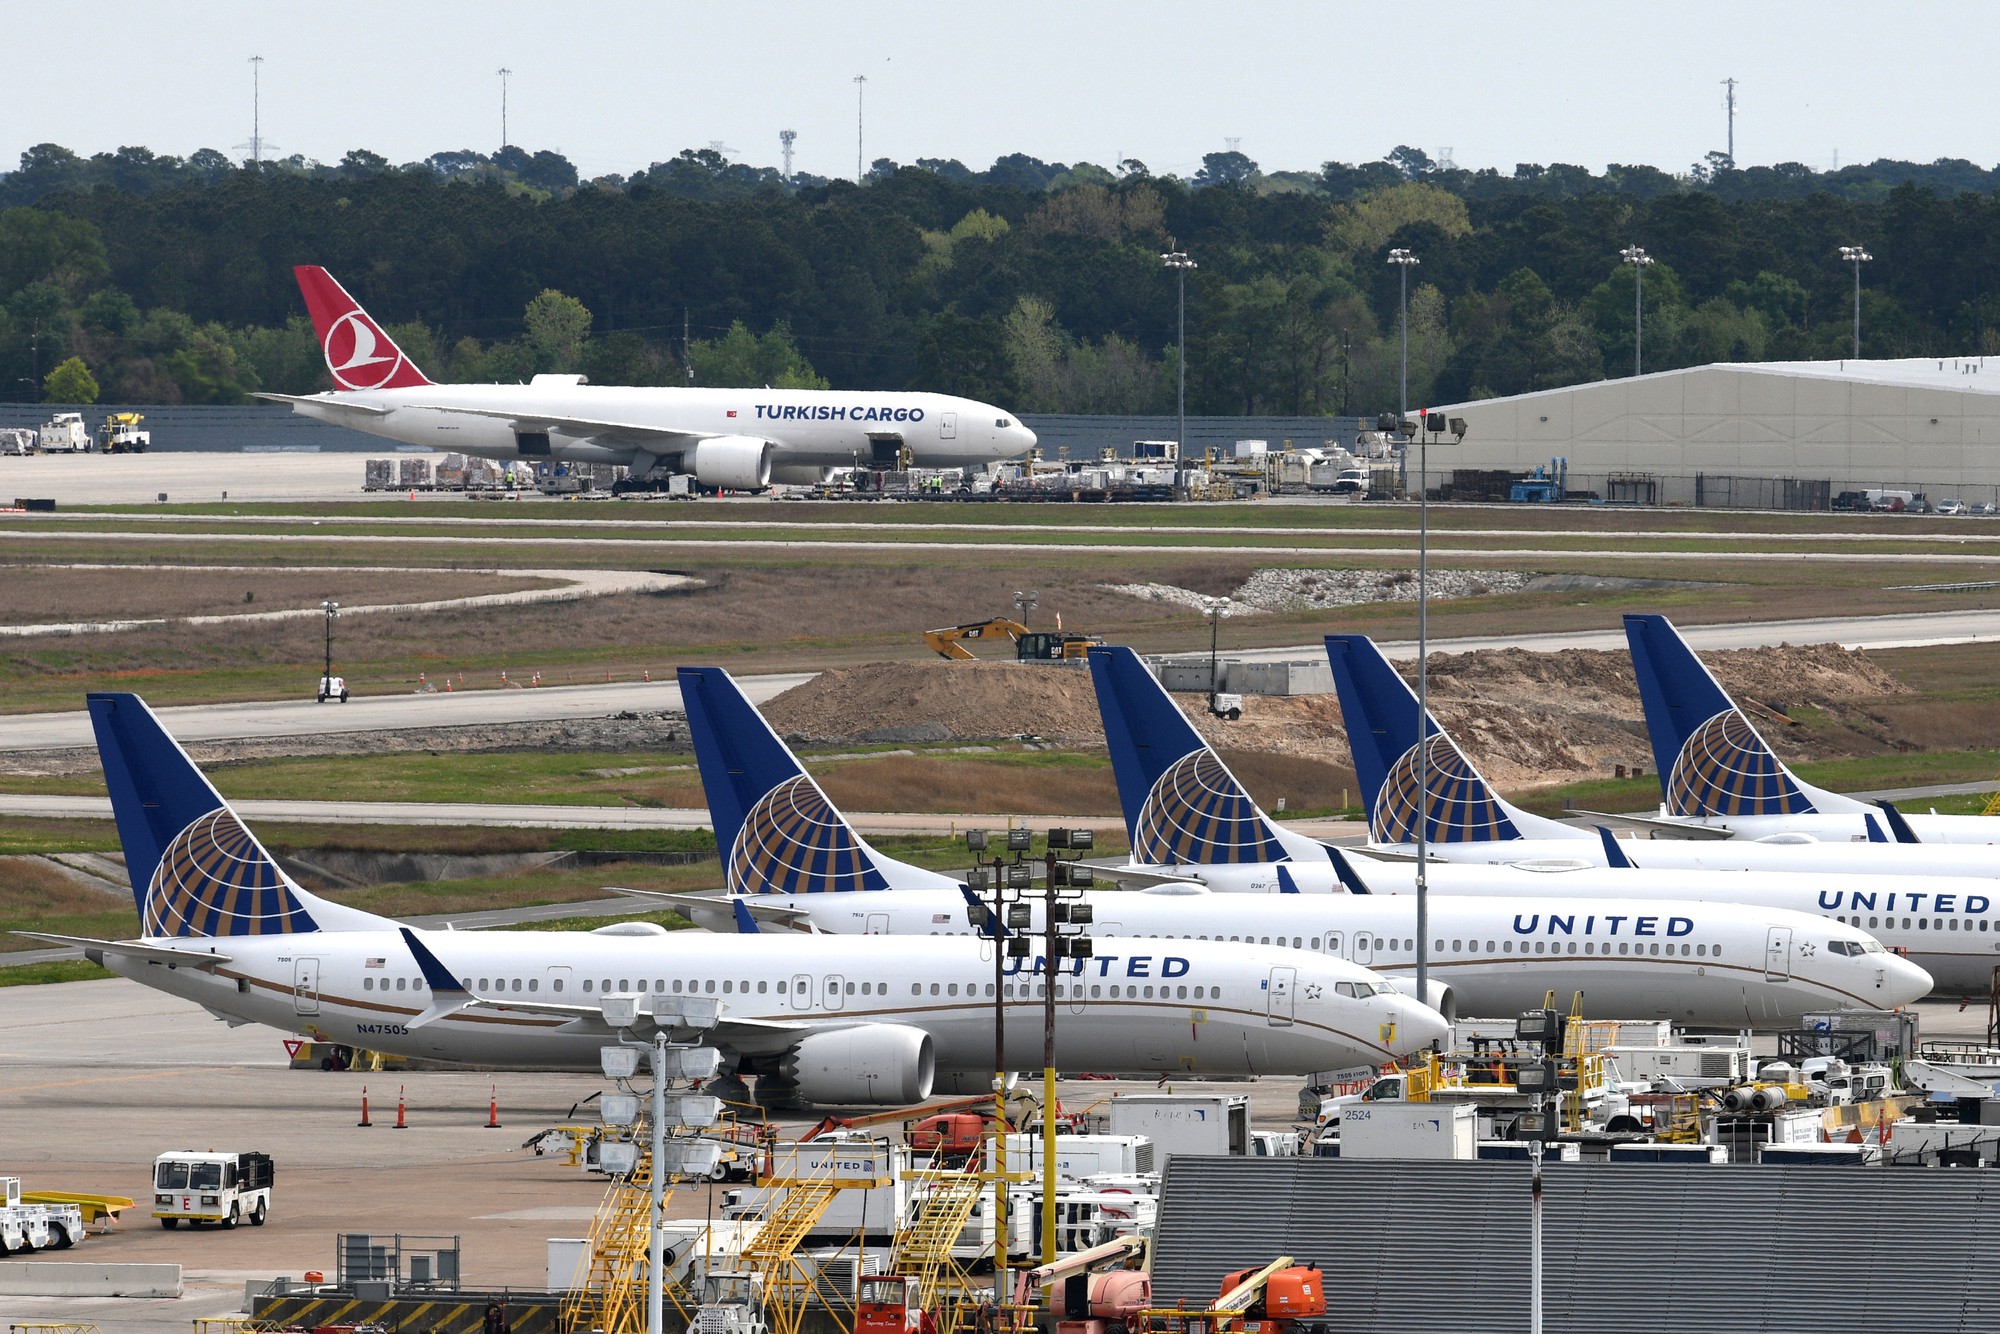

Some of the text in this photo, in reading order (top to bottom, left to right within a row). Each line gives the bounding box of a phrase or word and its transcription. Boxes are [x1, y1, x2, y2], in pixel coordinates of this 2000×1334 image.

[755, 405, 925, 422] TURKISH CARGO
[968, 630, 979, 638] CAT
[1051, 646, 1062, 655] CAT
[1818, 890, 1990, 914] UNITED
[1512, 914, 1694, 937] UNITED
[357, 1024, 409, 1035] N47505
[1336, 1072, 1353, 1080] 7505
[1345, 1110, 1372, 1121] 2524
[811, 1161, 860, 1170] UNITED
[183, 1196, 191, 1211] E
